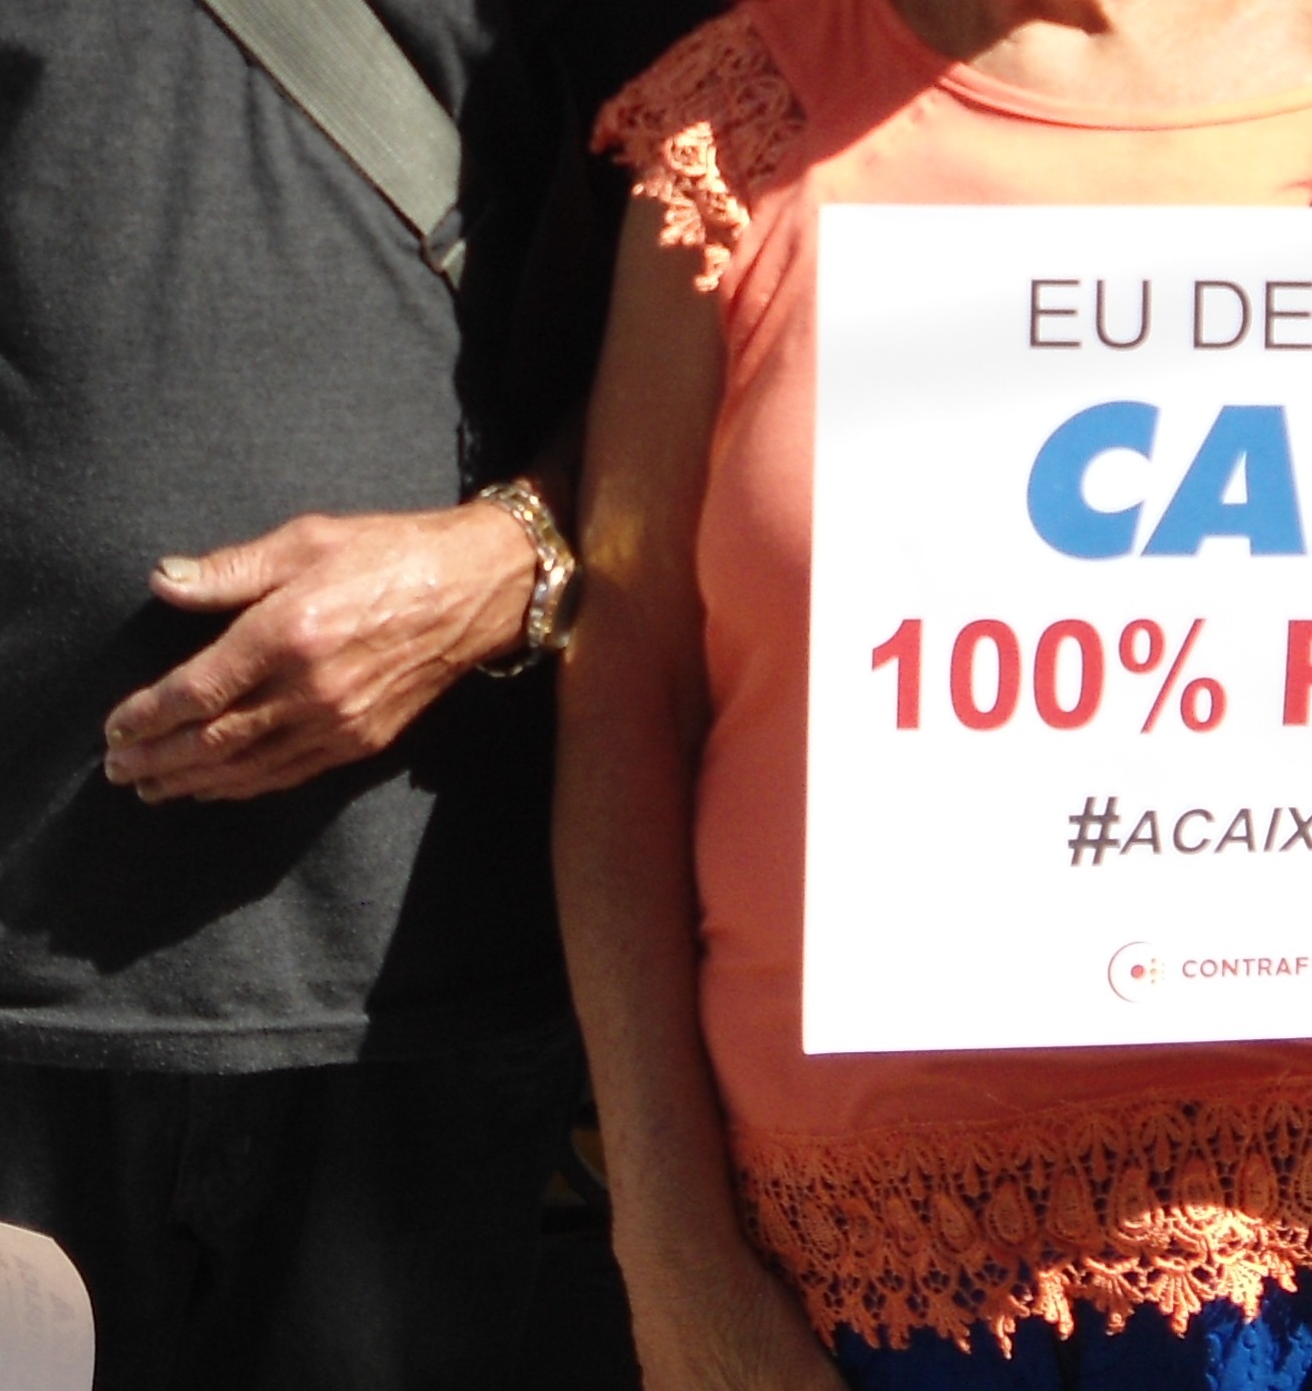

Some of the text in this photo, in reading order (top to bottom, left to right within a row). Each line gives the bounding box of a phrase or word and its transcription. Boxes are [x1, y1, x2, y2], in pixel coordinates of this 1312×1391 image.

[1029, 279, 1150, 350] EU
[870, 617, 1228, 734] 100%
[1181, 956, 1310, 979] CONTRAF
